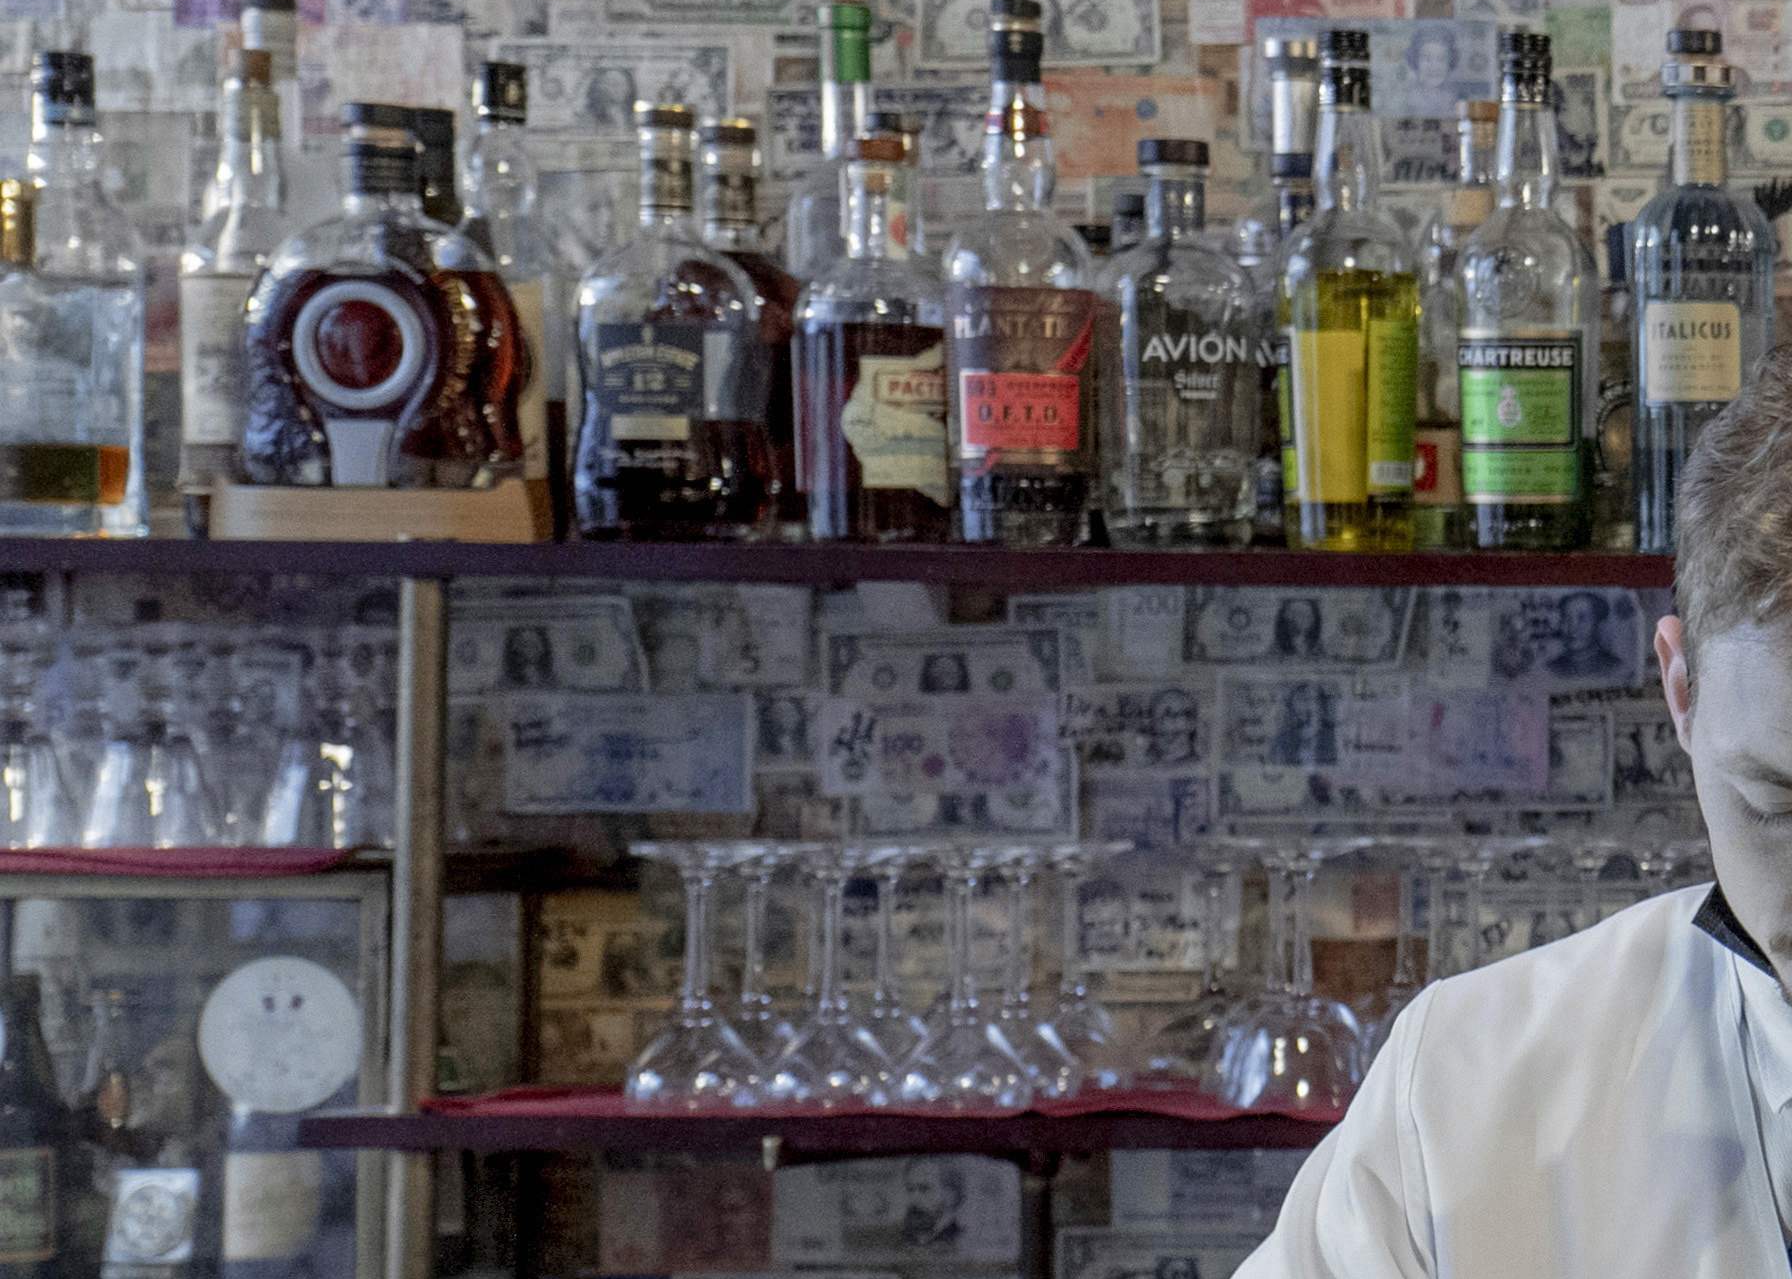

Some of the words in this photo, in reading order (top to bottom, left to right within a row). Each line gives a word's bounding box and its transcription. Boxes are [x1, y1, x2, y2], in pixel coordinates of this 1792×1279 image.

[1650, 320, 1732, 341] ITALICUS
[1142, 330, 1248, 364] AVIÓN
[1459, 346, 1575, 368] CHARTREUSE
